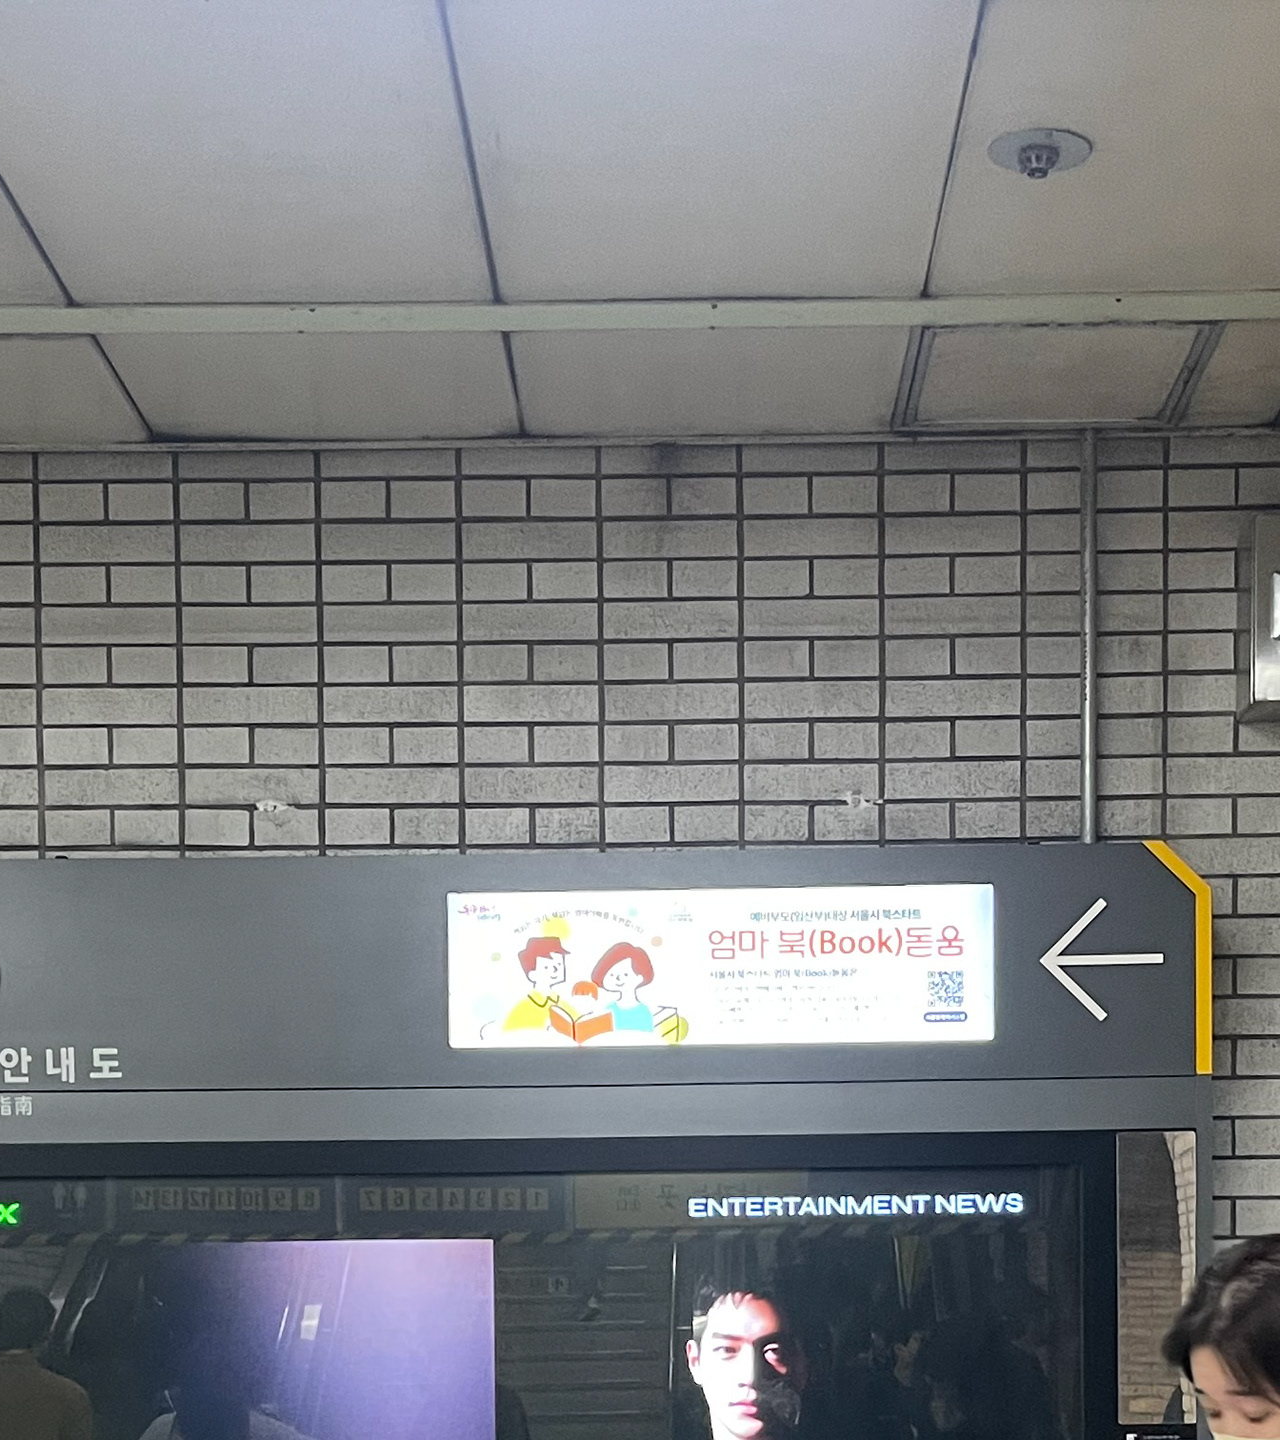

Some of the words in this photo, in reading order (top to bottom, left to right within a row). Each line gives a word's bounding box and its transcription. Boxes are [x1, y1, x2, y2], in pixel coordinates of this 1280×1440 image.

[708, 930, 769, 960] 엄마
[778, 925, 965, 958] 북(Book)돋움
[0, 1046, 123, 1084] 안내도
[687, 1195, 930, 1218] ENTERTAINMENT
[935, 1193, 1024, 1214] NEWS
